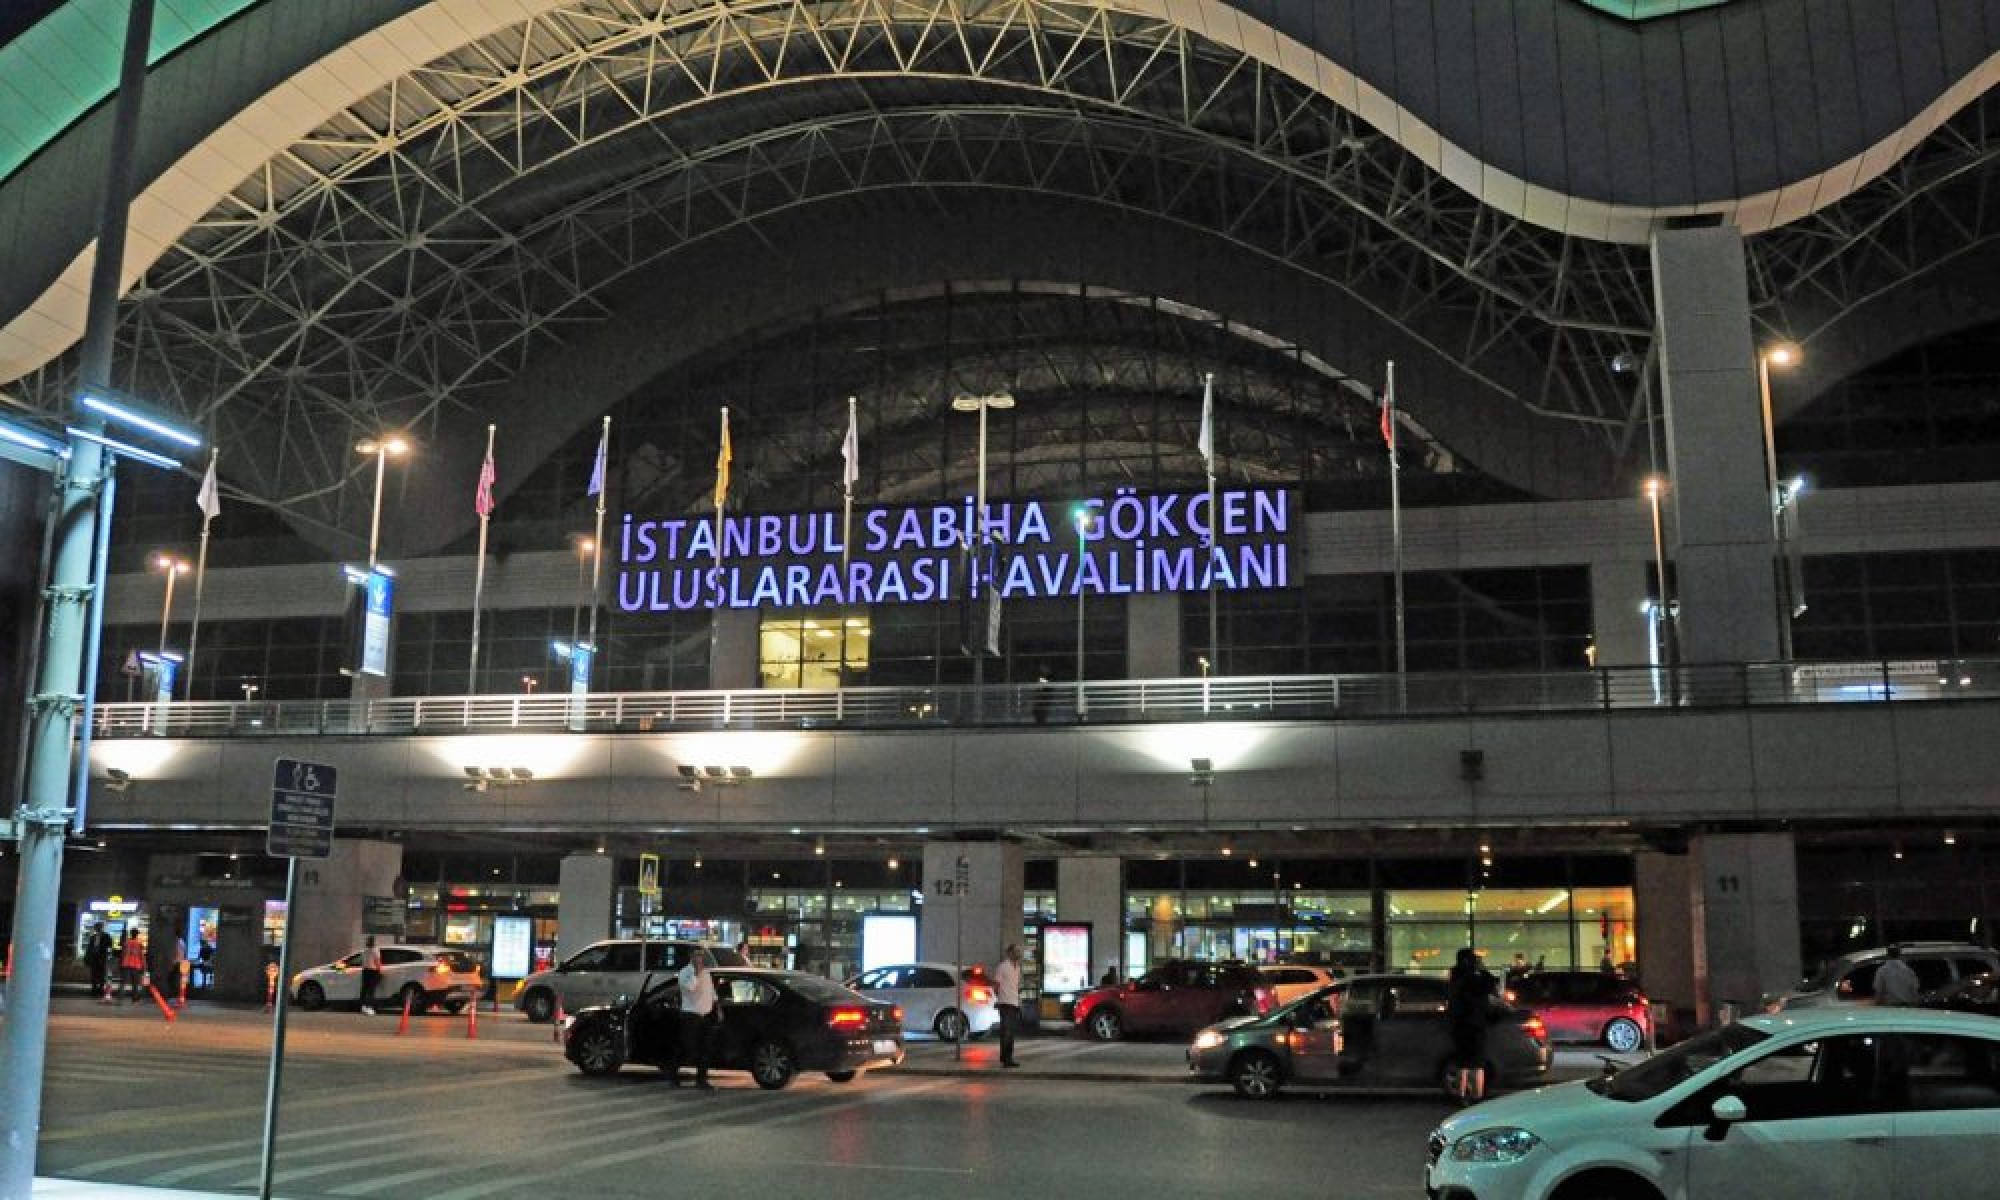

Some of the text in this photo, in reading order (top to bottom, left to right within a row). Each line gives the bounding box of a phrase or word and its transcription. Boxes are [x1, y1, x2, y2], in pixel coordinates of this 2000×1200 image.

[620, 487, 1287, 563] İSTANBUL SABİHA GÖKÇEN
[619, 557, 949, 611] ULUSLARARASI
[933, 879, 953, 896] 12
[1717, 874, 1739, 893] 11
